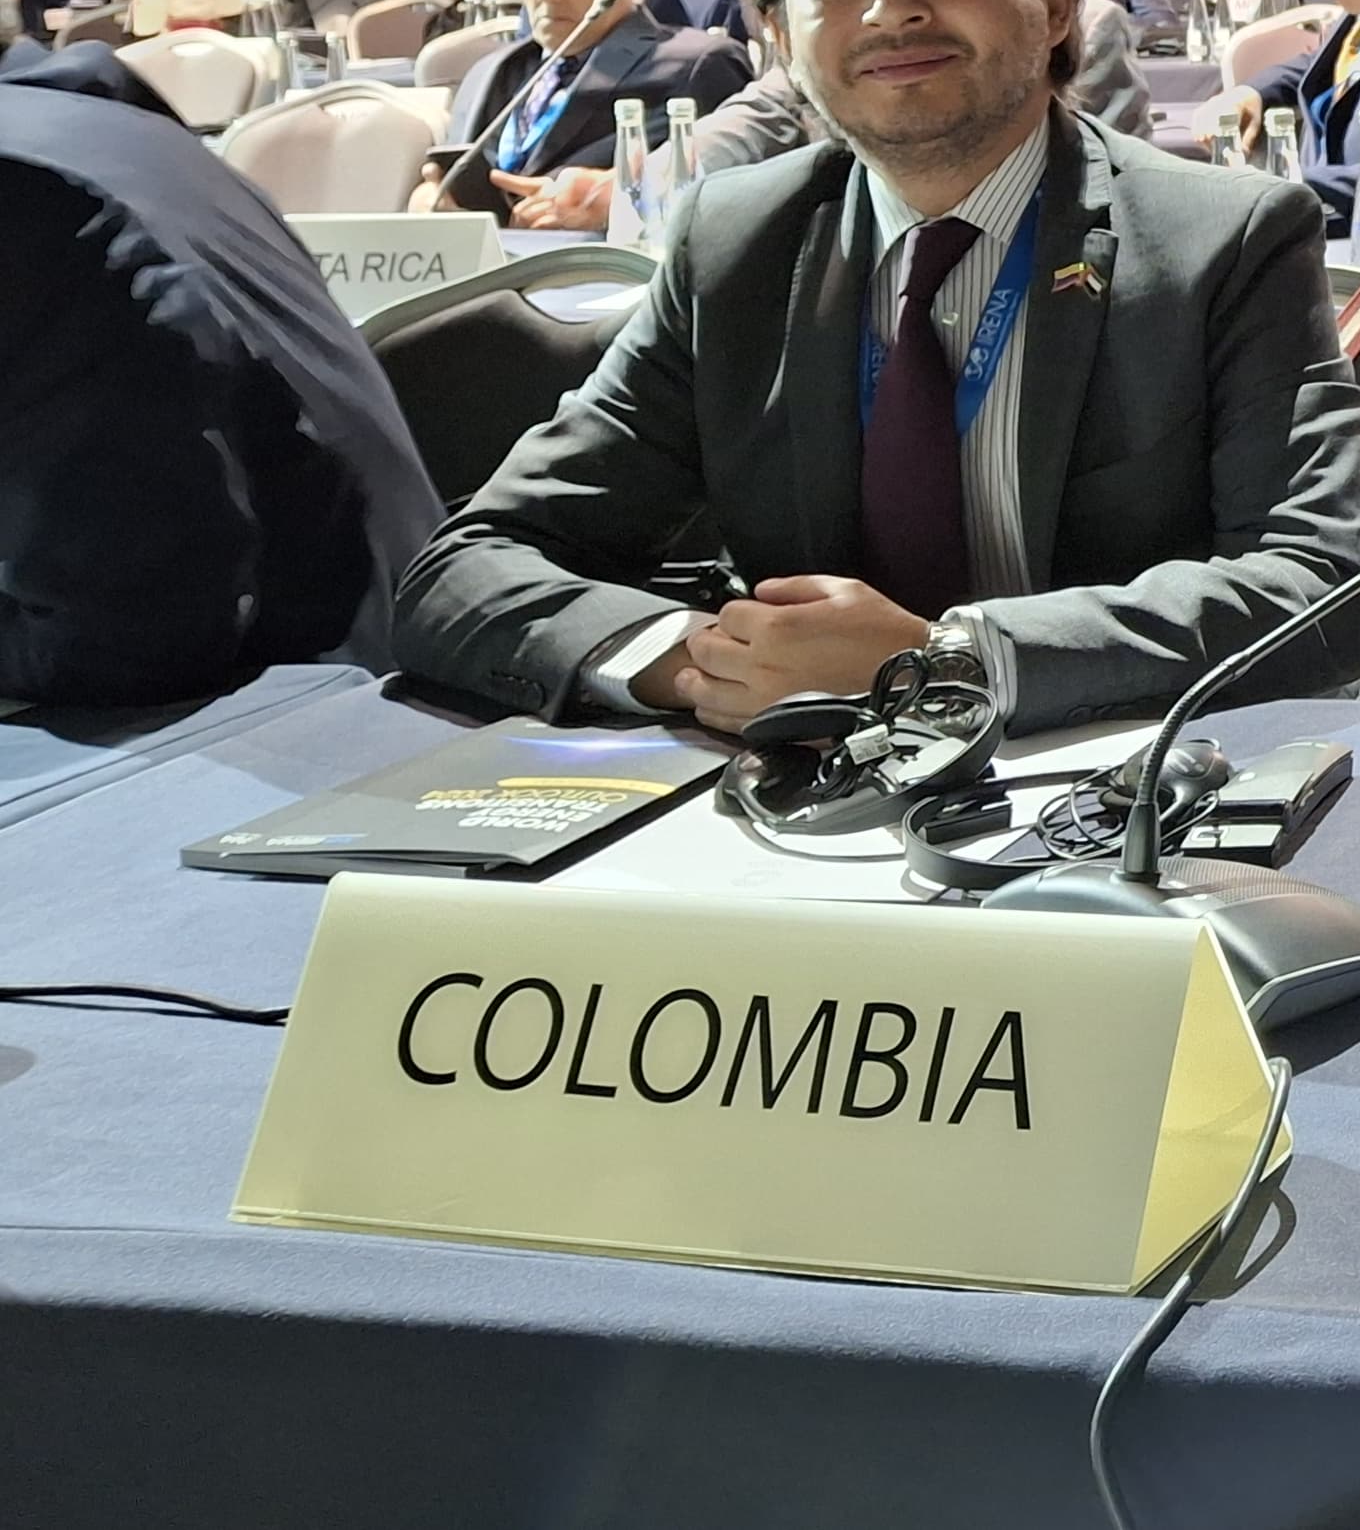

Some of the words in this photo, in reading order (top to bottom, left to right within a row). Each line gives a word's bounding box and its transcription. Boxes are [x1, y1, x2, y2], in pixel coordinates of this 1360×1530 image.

[359, 252, 446, 283] RICA
[978, 288, 1012, 345] IRENA
[458, 816, 570, 833] WORLD
[398, 972, 1031, 1130] COLOMBIA
